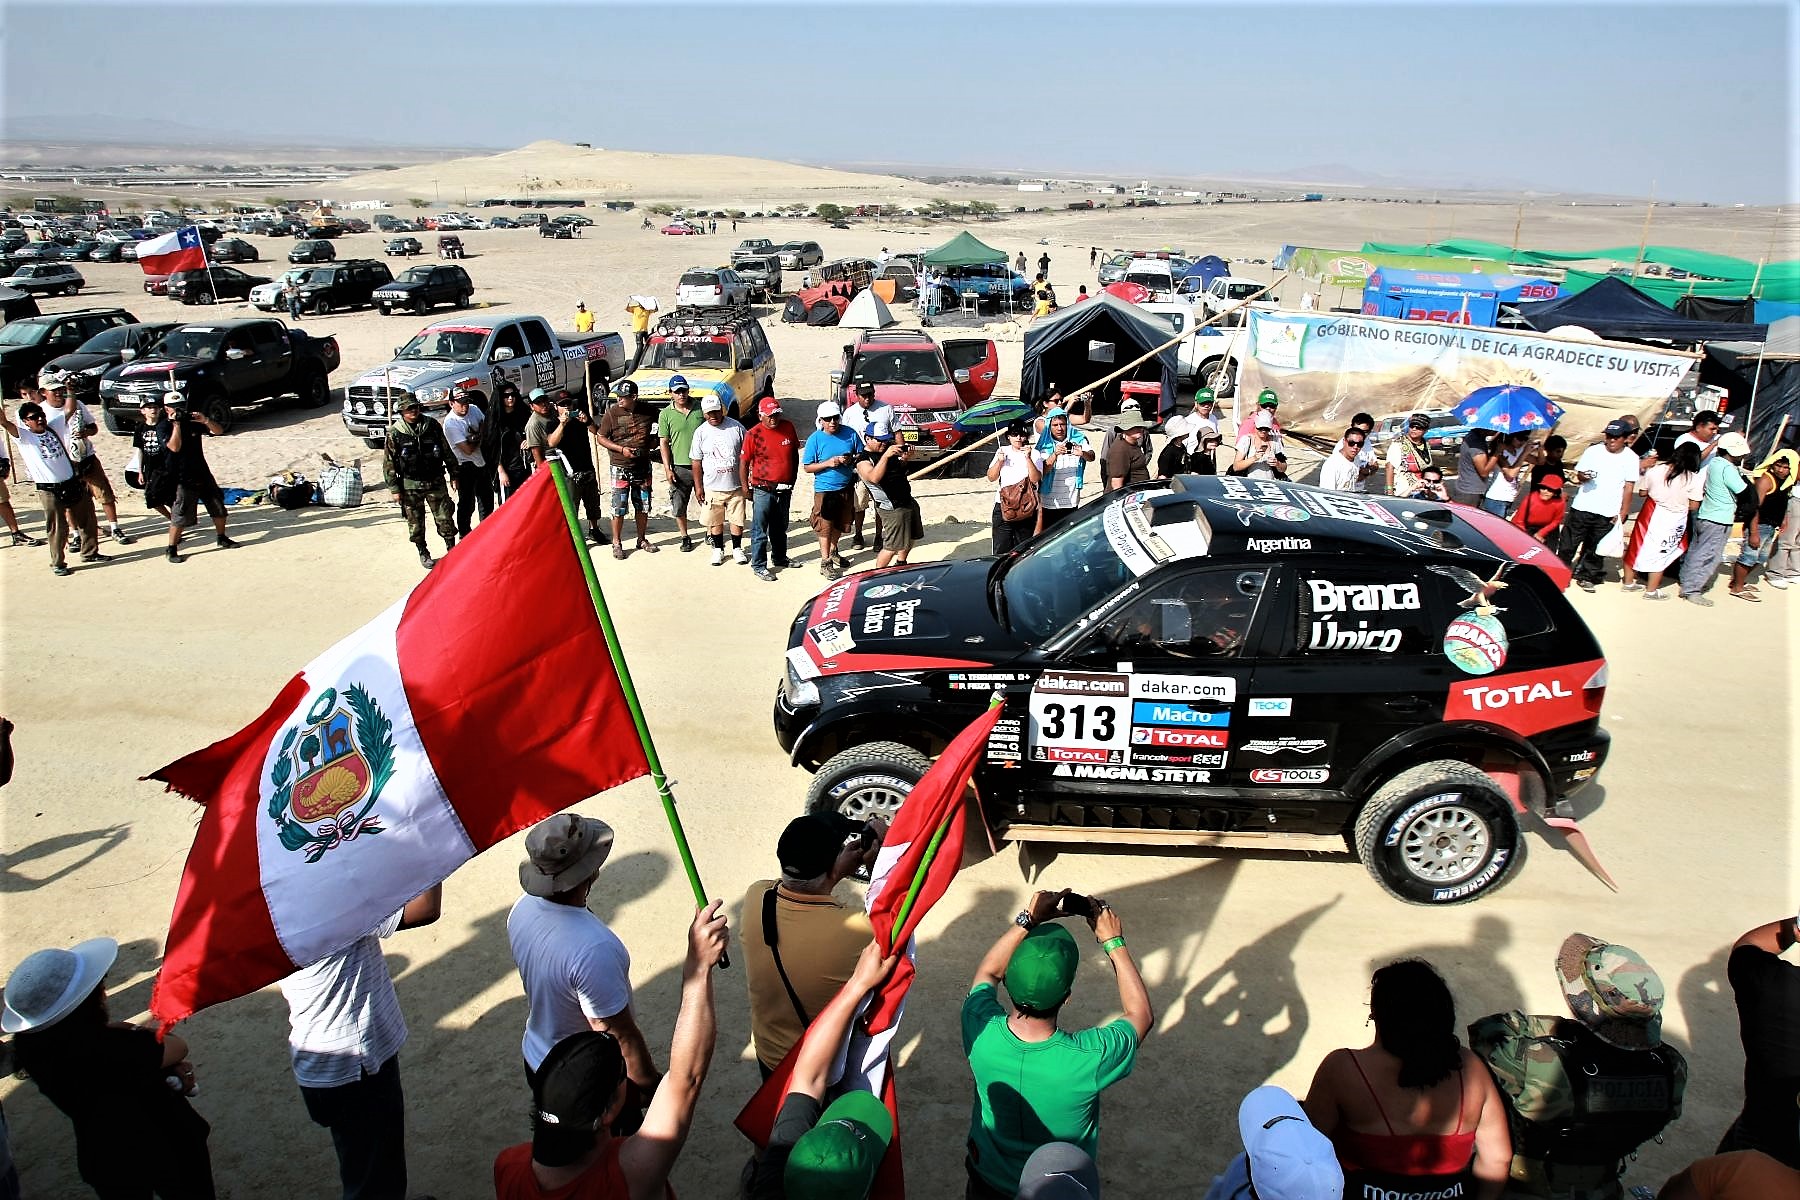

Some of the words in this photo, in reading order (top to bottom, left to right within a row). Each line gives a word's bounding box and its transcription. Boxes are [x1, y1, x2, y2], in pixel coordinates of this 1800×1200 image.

[1520, 284, 1558, 299] 360
[563, 347, 585, 359] TOTAL
[1317, 324, 1390, 341] GOBIERNO
[1394, 331, 1467, 350] REGIONAL
[1472, 338, 1489, 353] DE
[1493, 341, 1518, 357] ICA
[1522, 345, 1604, 369] AGRADECE
[1607, 356, 1629, 372] SU
[1633, 360, 1680, 378] VISITA
[1117, 532, 1137, 559] Power
[1246, 537, 1312, 554] Argentina
[822, 580, 851, 618] TOTAL
[1306, 579, 1421, 612] Branca
[863, 602, 896, 634] Único
[893, 598, 922, 637] Branca
[1308, 613, 1403, 653] Único
[1446, 624, 1502, 668] BRANCA
[1038, 674, 1125, 692] dakar.com
[1141, 680, 1227, 696] dakar.com
[1463, 680, 1573, 711] TOTAL
[1042, 702, 1117, 742] 313
[1152, 706, 1212, 723] Macro
[1154, 729, 1225, 746] TOTAL
[1050, 748, 1106, 761] TOTAL
[1073, 764, 1150, 781] MAGNA
[1150, 768, 1212, 784] STEYR
[1255, 770, 1283, 781] KS
[1283, 770, 1322, 780] TOOLS
[1394, 793, 1463, 828] MICHELIN
[1434, 862, 1500, 901] MICHELIN
